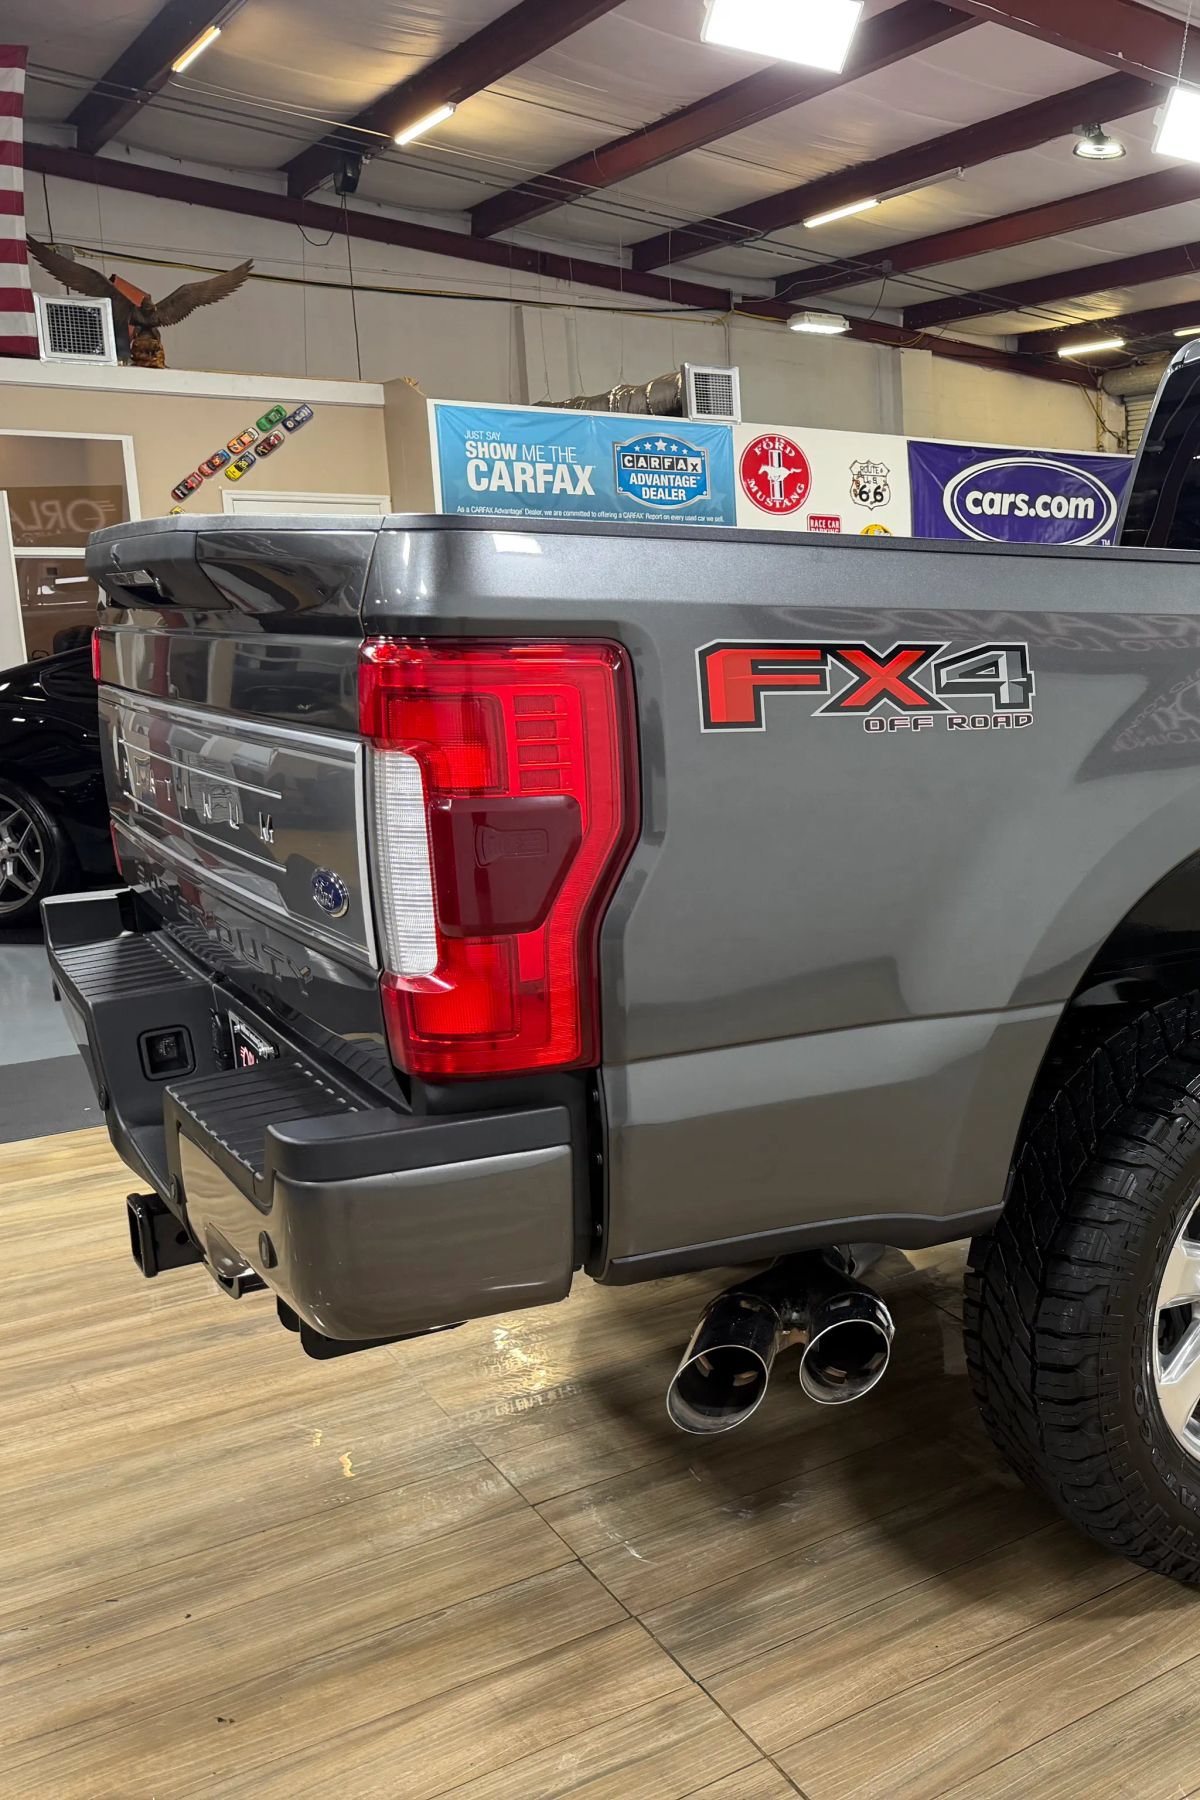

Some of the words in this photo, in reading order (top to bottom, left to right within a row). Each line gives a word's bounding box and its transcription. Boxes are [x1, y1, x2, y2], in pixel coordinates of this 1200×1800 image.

[464, 431, 485, 440] JUST
[486, 431, 501, 441] SAY
[465, 441, 518, 461] SHOW
[522, 444, 546, 462] ME
[548, 445, 578, 463] THE
[753, 438, 796, 457] FORD
[623, 454, 700, 473] CARFAX
[860, 465, 880, 475] ROUTE
[466, 458, 596, 496] CARFAX
[629, 473, 698, 488] ADVANTAGE
[641, 487, 687, 501] DEALER
[747, 478, 805, 509] MUSTANG
[470, 505, 494, 514] CARFAX
[645, 512, 662, 520] Report
[671, 514, 684, 522] every
[965, 490, 1095, 519] cars.com
[827, 520, 840, 529] CAR
[694, 639, 1035, 733] FX4
[862, 714, 936, 733] OFF
[946, 712, 1035, 731] ROAD
